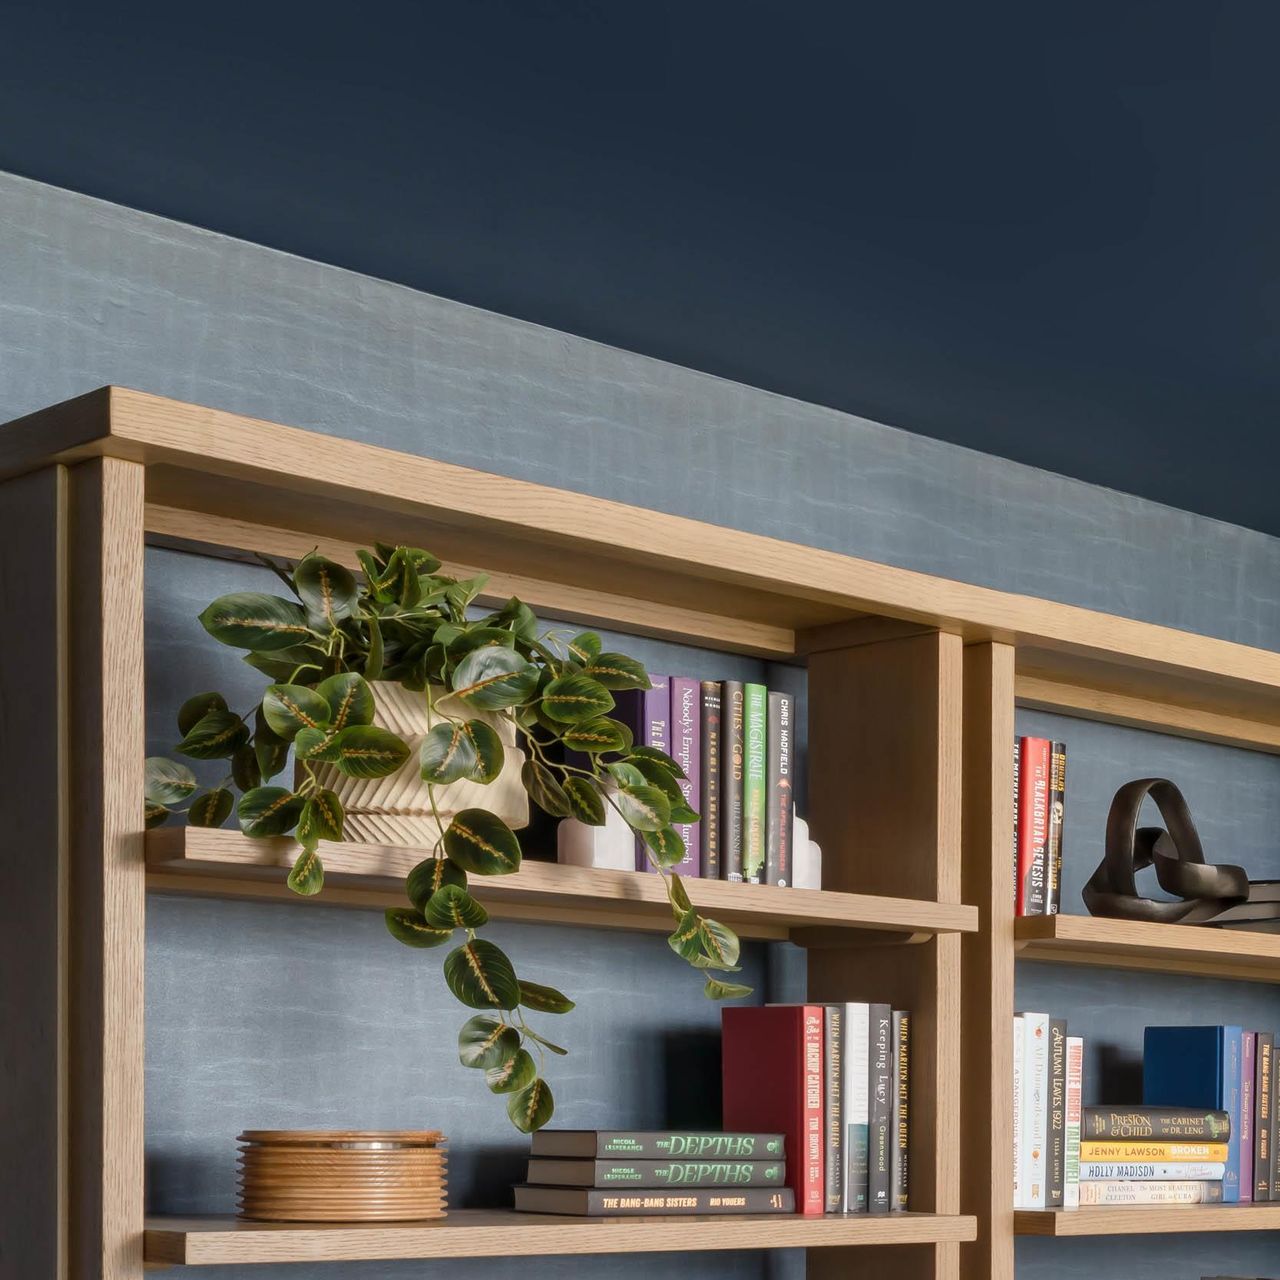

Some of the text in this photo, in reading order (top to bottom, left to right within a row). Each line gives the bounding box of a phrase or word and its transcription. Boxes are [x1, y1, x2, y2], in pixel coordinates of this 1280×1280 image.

[678, 687, 692, 733] Nobody's
[679, 736, 692, 774] Empire
[729, 691, 742, 780] CITIES GOLD
[749, 693, 764, 780] THE MAGISTRATE
[780, 730, 788, 774] HADFIELD
[709, 796, 718, 865] SHANGHAI
[1033, 780, 1045, 843] BLACKBRIAR
[1032, 846, 1044, 887] GENESIS
[807, 1042, 819, 1076] BACKUP
[876, 1019, 889, 1104] Keeping Lucy
[1052, 1027, 1064, 1130] AUTUMN 1922
[1069, 1045, 1082, 1086] VIBRATE
[807, 1078, 819, 1109] CATCHER
[831, 1014, 840, 1148] WHEN MARILYN MET THE QUEEN
[899, 1017, 908, 1148] WHEN MARILYN MET THE QUEEN
[809, 1117, 819, 1160] TIM BROWN
[1111, 1114, 1151, 1126] PRESTON
[1089, 1147, 1165, 1156] JENNY LAWSON
[1089, 1166, 1155, 1177] HOLLY MADISON
[1170, 1146, 1209, 1154] BROKEN
[603, 1198, 697, 1208] THE BANG-BANG SISTERS
